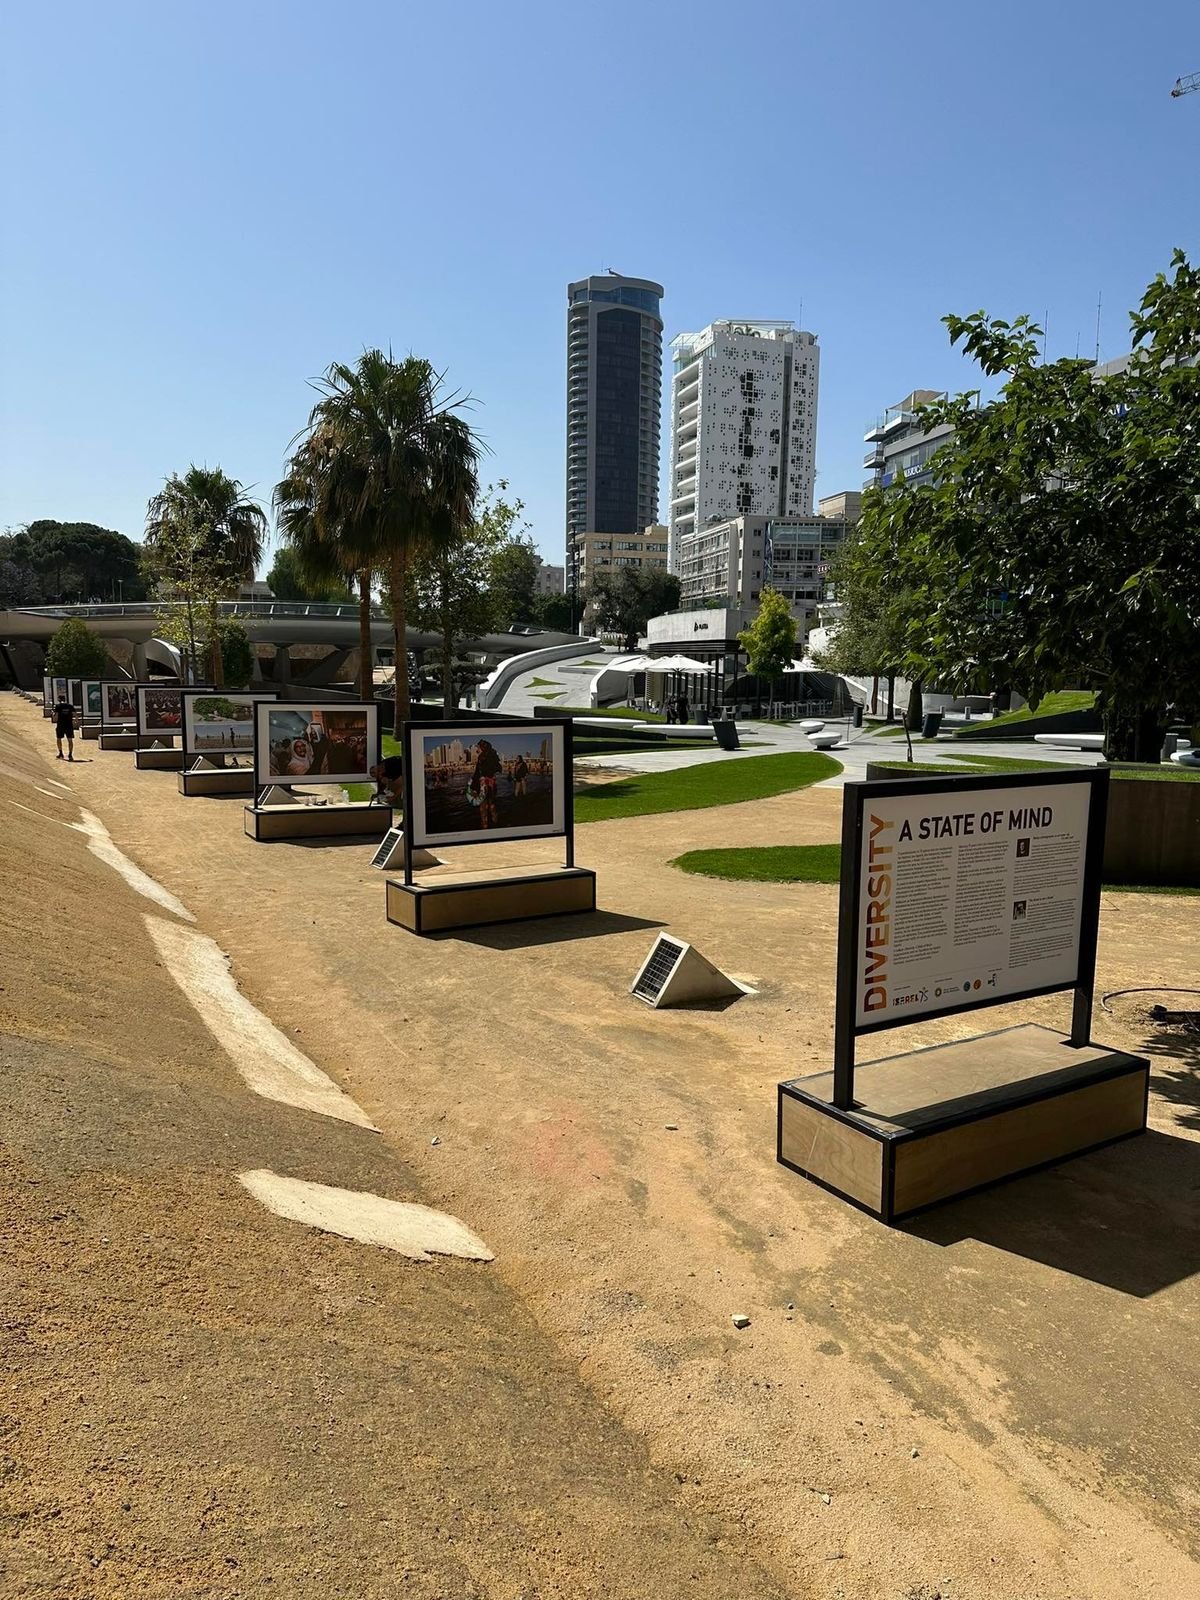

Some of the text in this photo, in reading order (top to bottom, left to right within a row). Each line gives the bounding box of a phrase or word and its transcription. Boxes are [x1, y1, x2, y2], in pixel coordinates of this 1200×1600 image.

[898, 806, 1053, 842] A STATE OF MIND
[863, 813, 895, 1013] DIVERSITY
